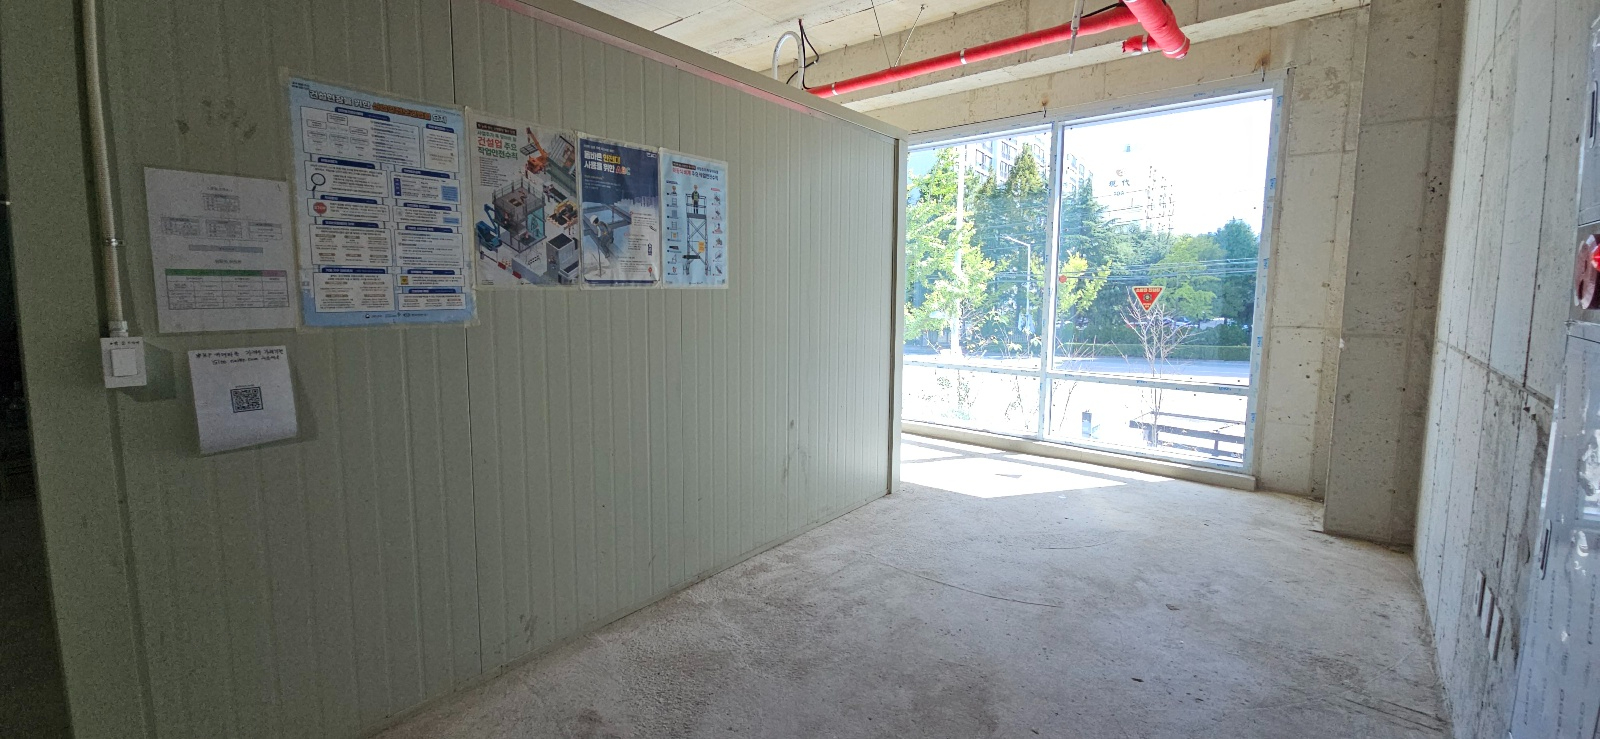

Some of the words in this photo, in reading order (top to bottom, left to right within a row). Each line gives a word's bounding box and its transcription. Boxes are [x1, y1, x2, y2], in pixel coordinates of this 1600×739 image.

[477, 136, 503, 149] 건설업
[503, 142, 517, 151] 주요
[477, 146, 518, 160] 작업안전수칙
